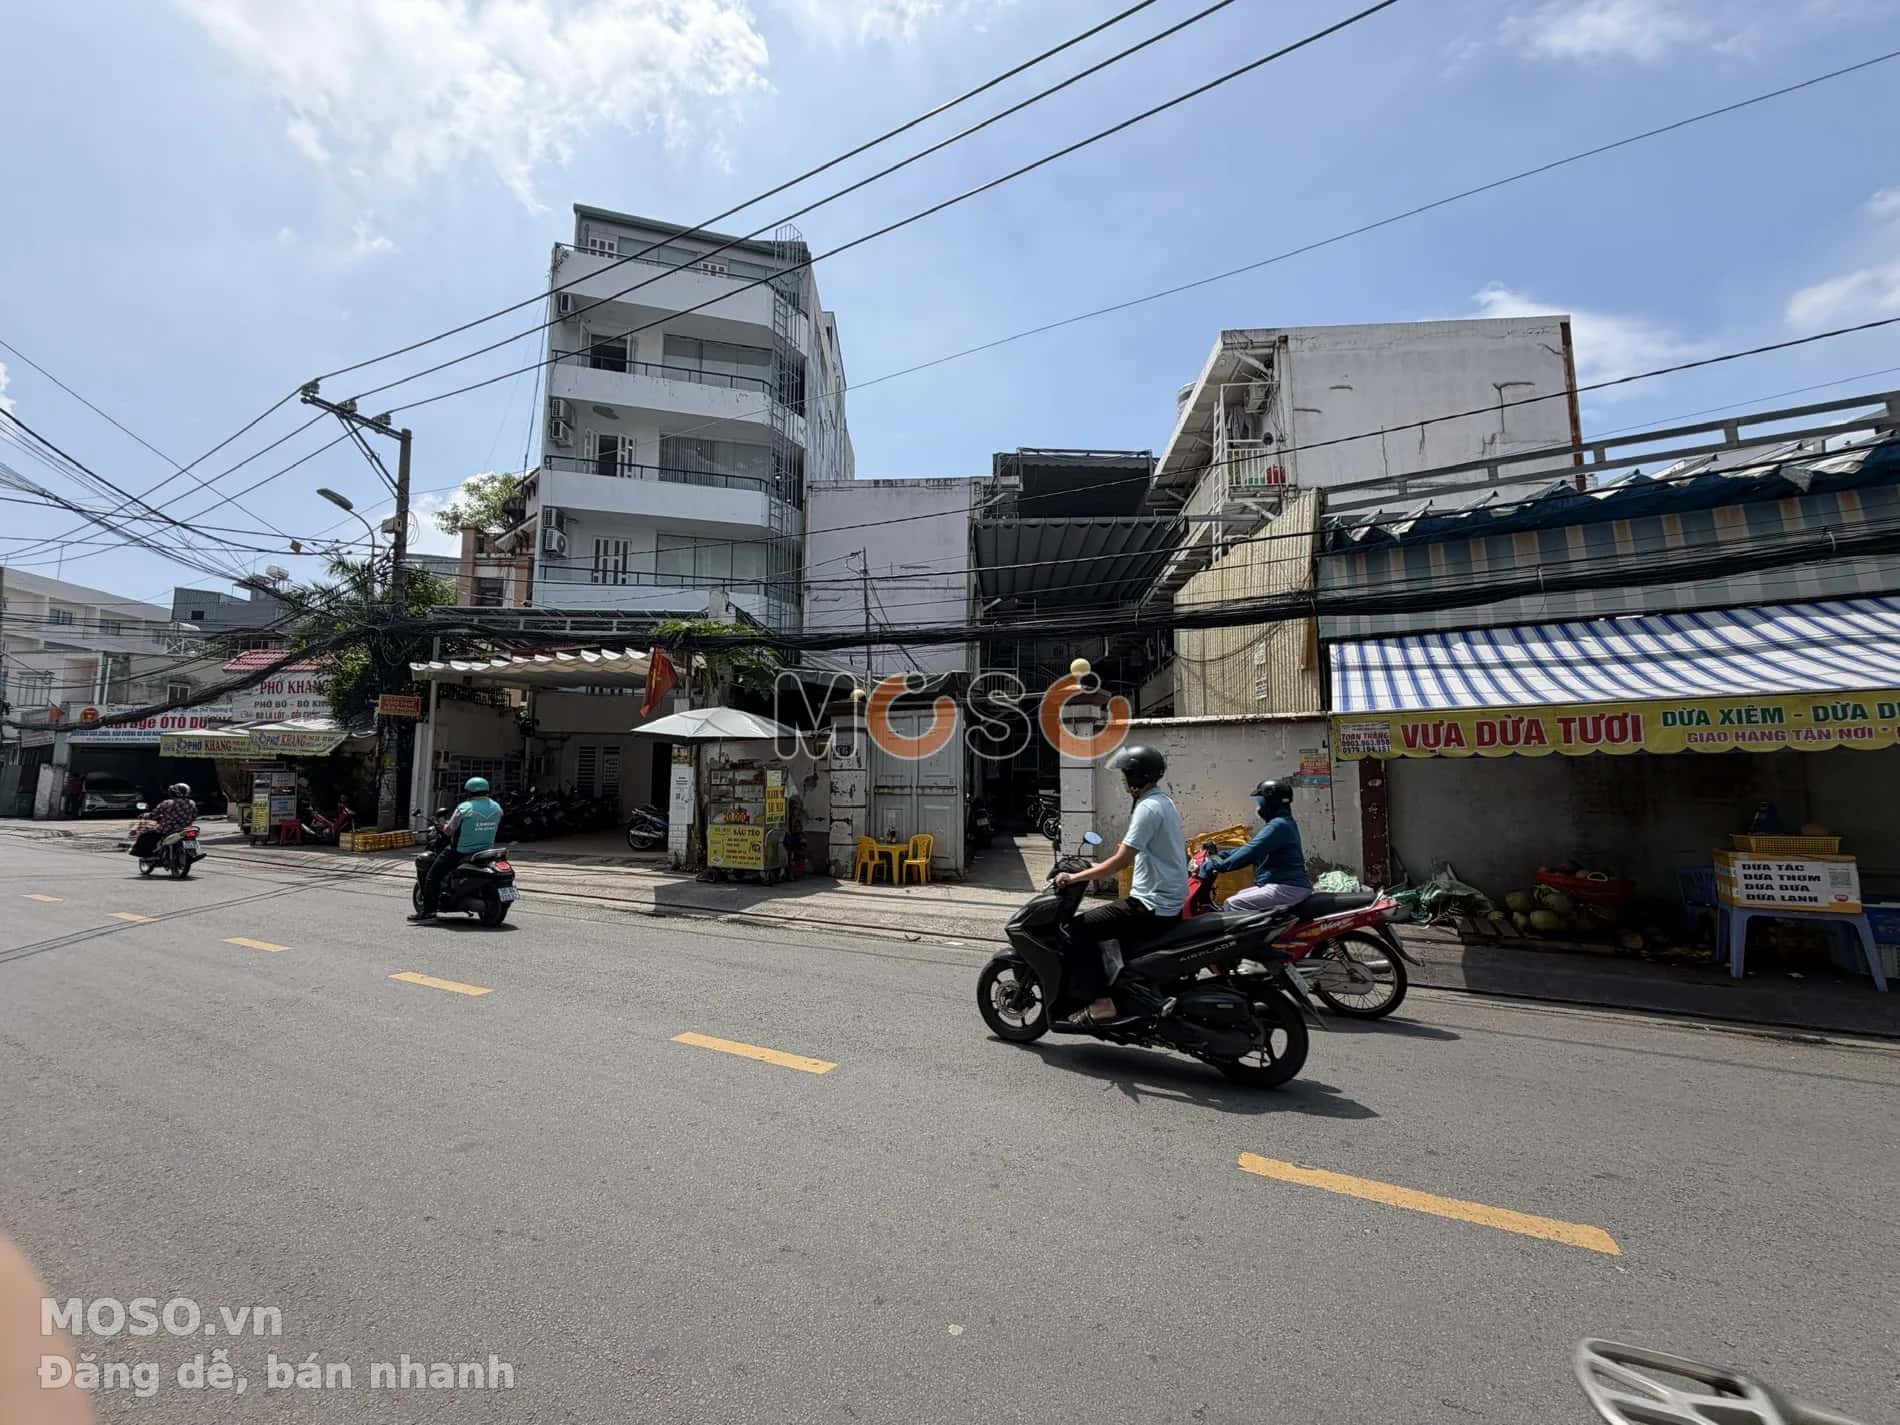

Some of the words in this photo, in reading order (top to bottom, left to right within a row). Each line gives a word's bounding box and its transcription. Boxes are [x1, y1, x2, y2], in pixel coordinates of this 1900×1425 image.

[1662, 707, 1712, 727] DỪA
[1719, 704, 1784, 725] XIÊM
[1812, 701, 1869, 721] DỪA
[1400, 719, 1465, 753] VỰA
[1475, 714, 1547, 747] DỪA
[1556, 712, 1643, 745] TƯƠI
[1687, 732, 1729, 743] GIAO
